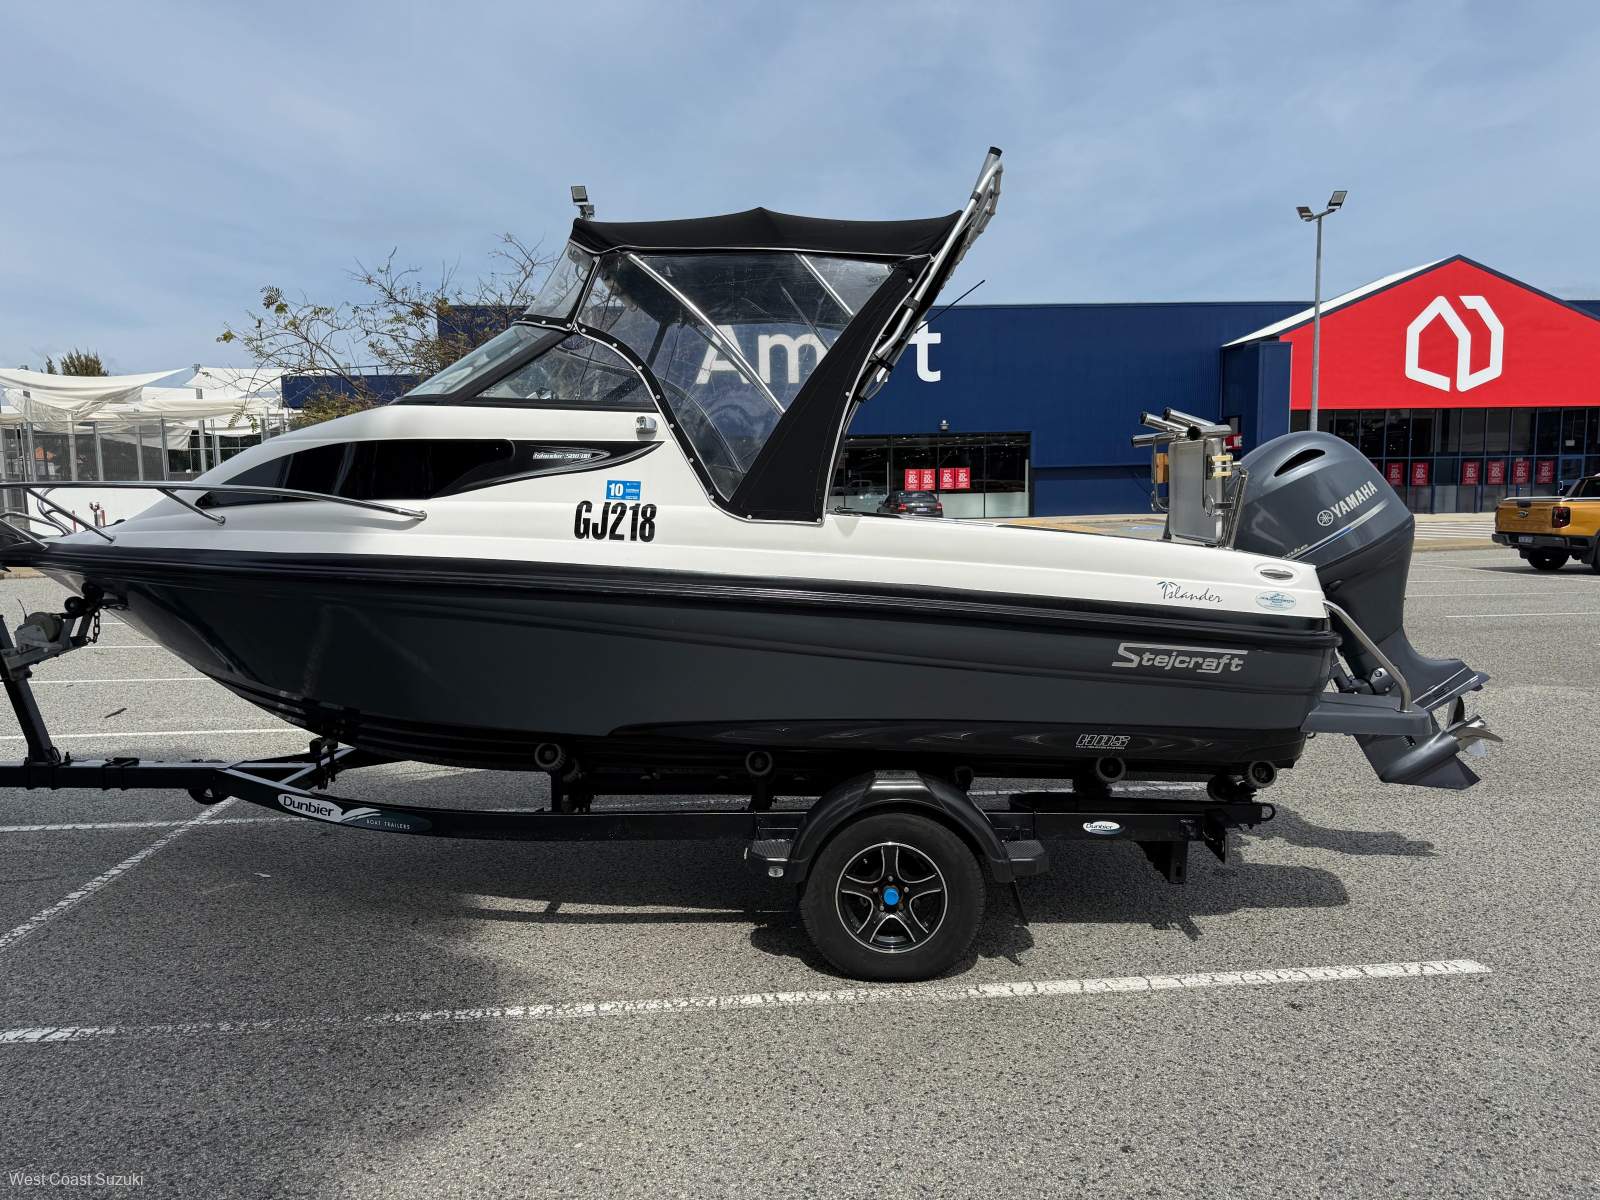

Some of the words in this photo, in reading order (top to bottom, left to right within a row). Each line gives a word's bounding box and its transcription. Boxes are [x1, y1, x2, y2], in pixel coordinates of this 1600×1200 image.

[696, 320, 941, 384] Amt
[608, 482, 624, 497] 10
[1329, 480, 1378, 518] YAMAHA
[574, 500, 657, 542] GJ218
[1157, 581, 1223, 603] Islander
[283, 795, 335, 817] Dunbier
